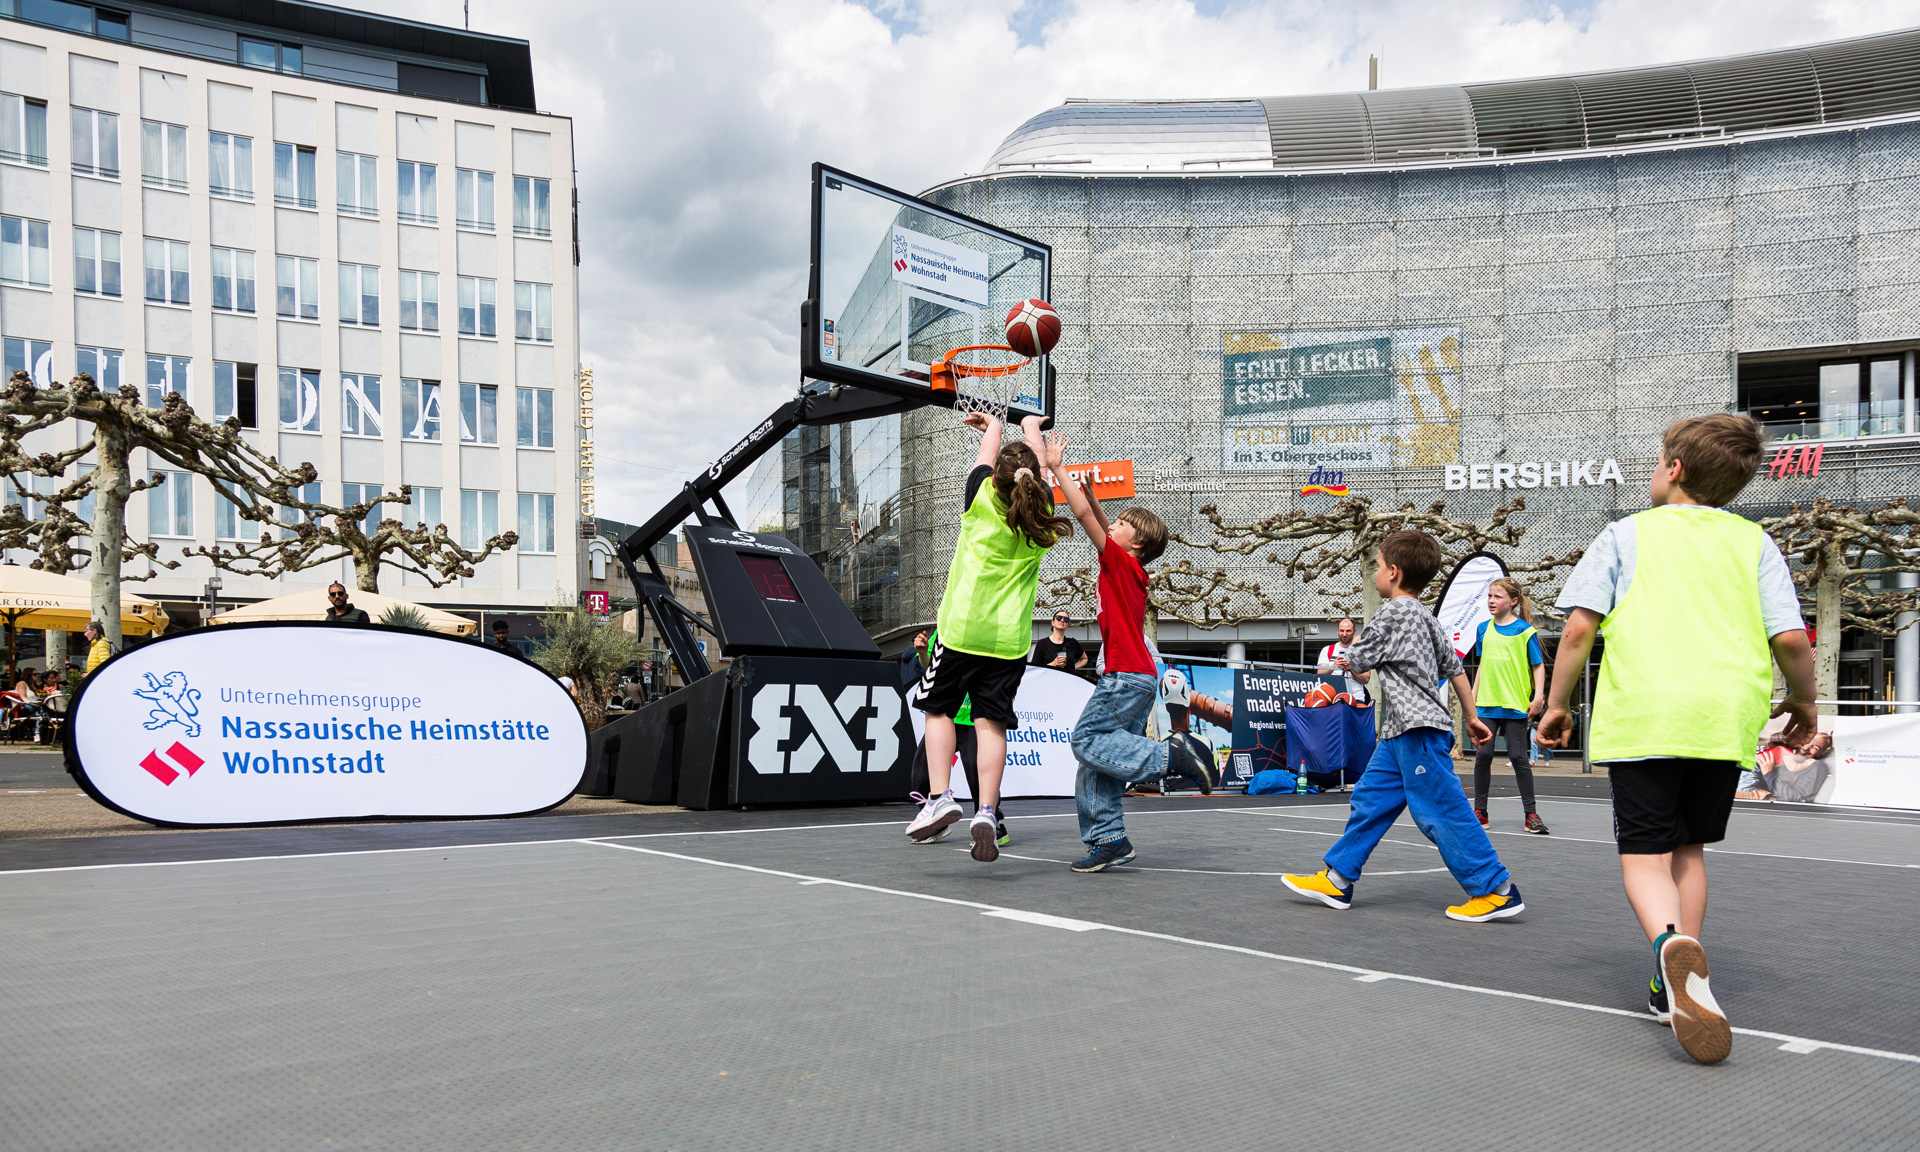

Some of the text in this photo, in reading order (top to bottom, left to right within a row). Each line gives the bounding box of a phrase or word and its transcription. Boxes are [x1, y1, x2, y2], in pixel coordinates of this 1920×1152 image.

[911, 253, 988, 283] Nassauische Heimstätte
[911, 264, 947, 282] Wohnstadt
[1234, 348, 1386, 382] ECHT LECKER.
[579, 366, 594, 429] CELONA
[1234, 379, 1311, 405] ESSEN.
[721, 439, 749, 466] Schelde
[749, 418, 773, 442] Sports
[1235, 425, 1373, 445] FOOD POINT
[580, 438, 595, 469] BAR
[1271, 450, 1373, 466] Obergeschoss
[1767, 444, 1825, 479] H&M
[1154, 468, 1180, 479] gute
[1308, 466, 1343, 485] dm
[1444, 459, 1625, 490] BERSHKA
[1154, 480, 1226, 492] Lebensmittel
[762, 574, 795, 598] 12
[590, 594, 604, 610] T
[220, 687, 422, 711] Unternehmensgruppe
[1246, 695, 1282, 713] made
[221, 716, 550, 741] Nassauische Heimstätte
[1050, 728, 1073, 743] Hei
[1249, 721, 1275, 731] Regional
[222, 749, 386, 774] Wohnstadt
